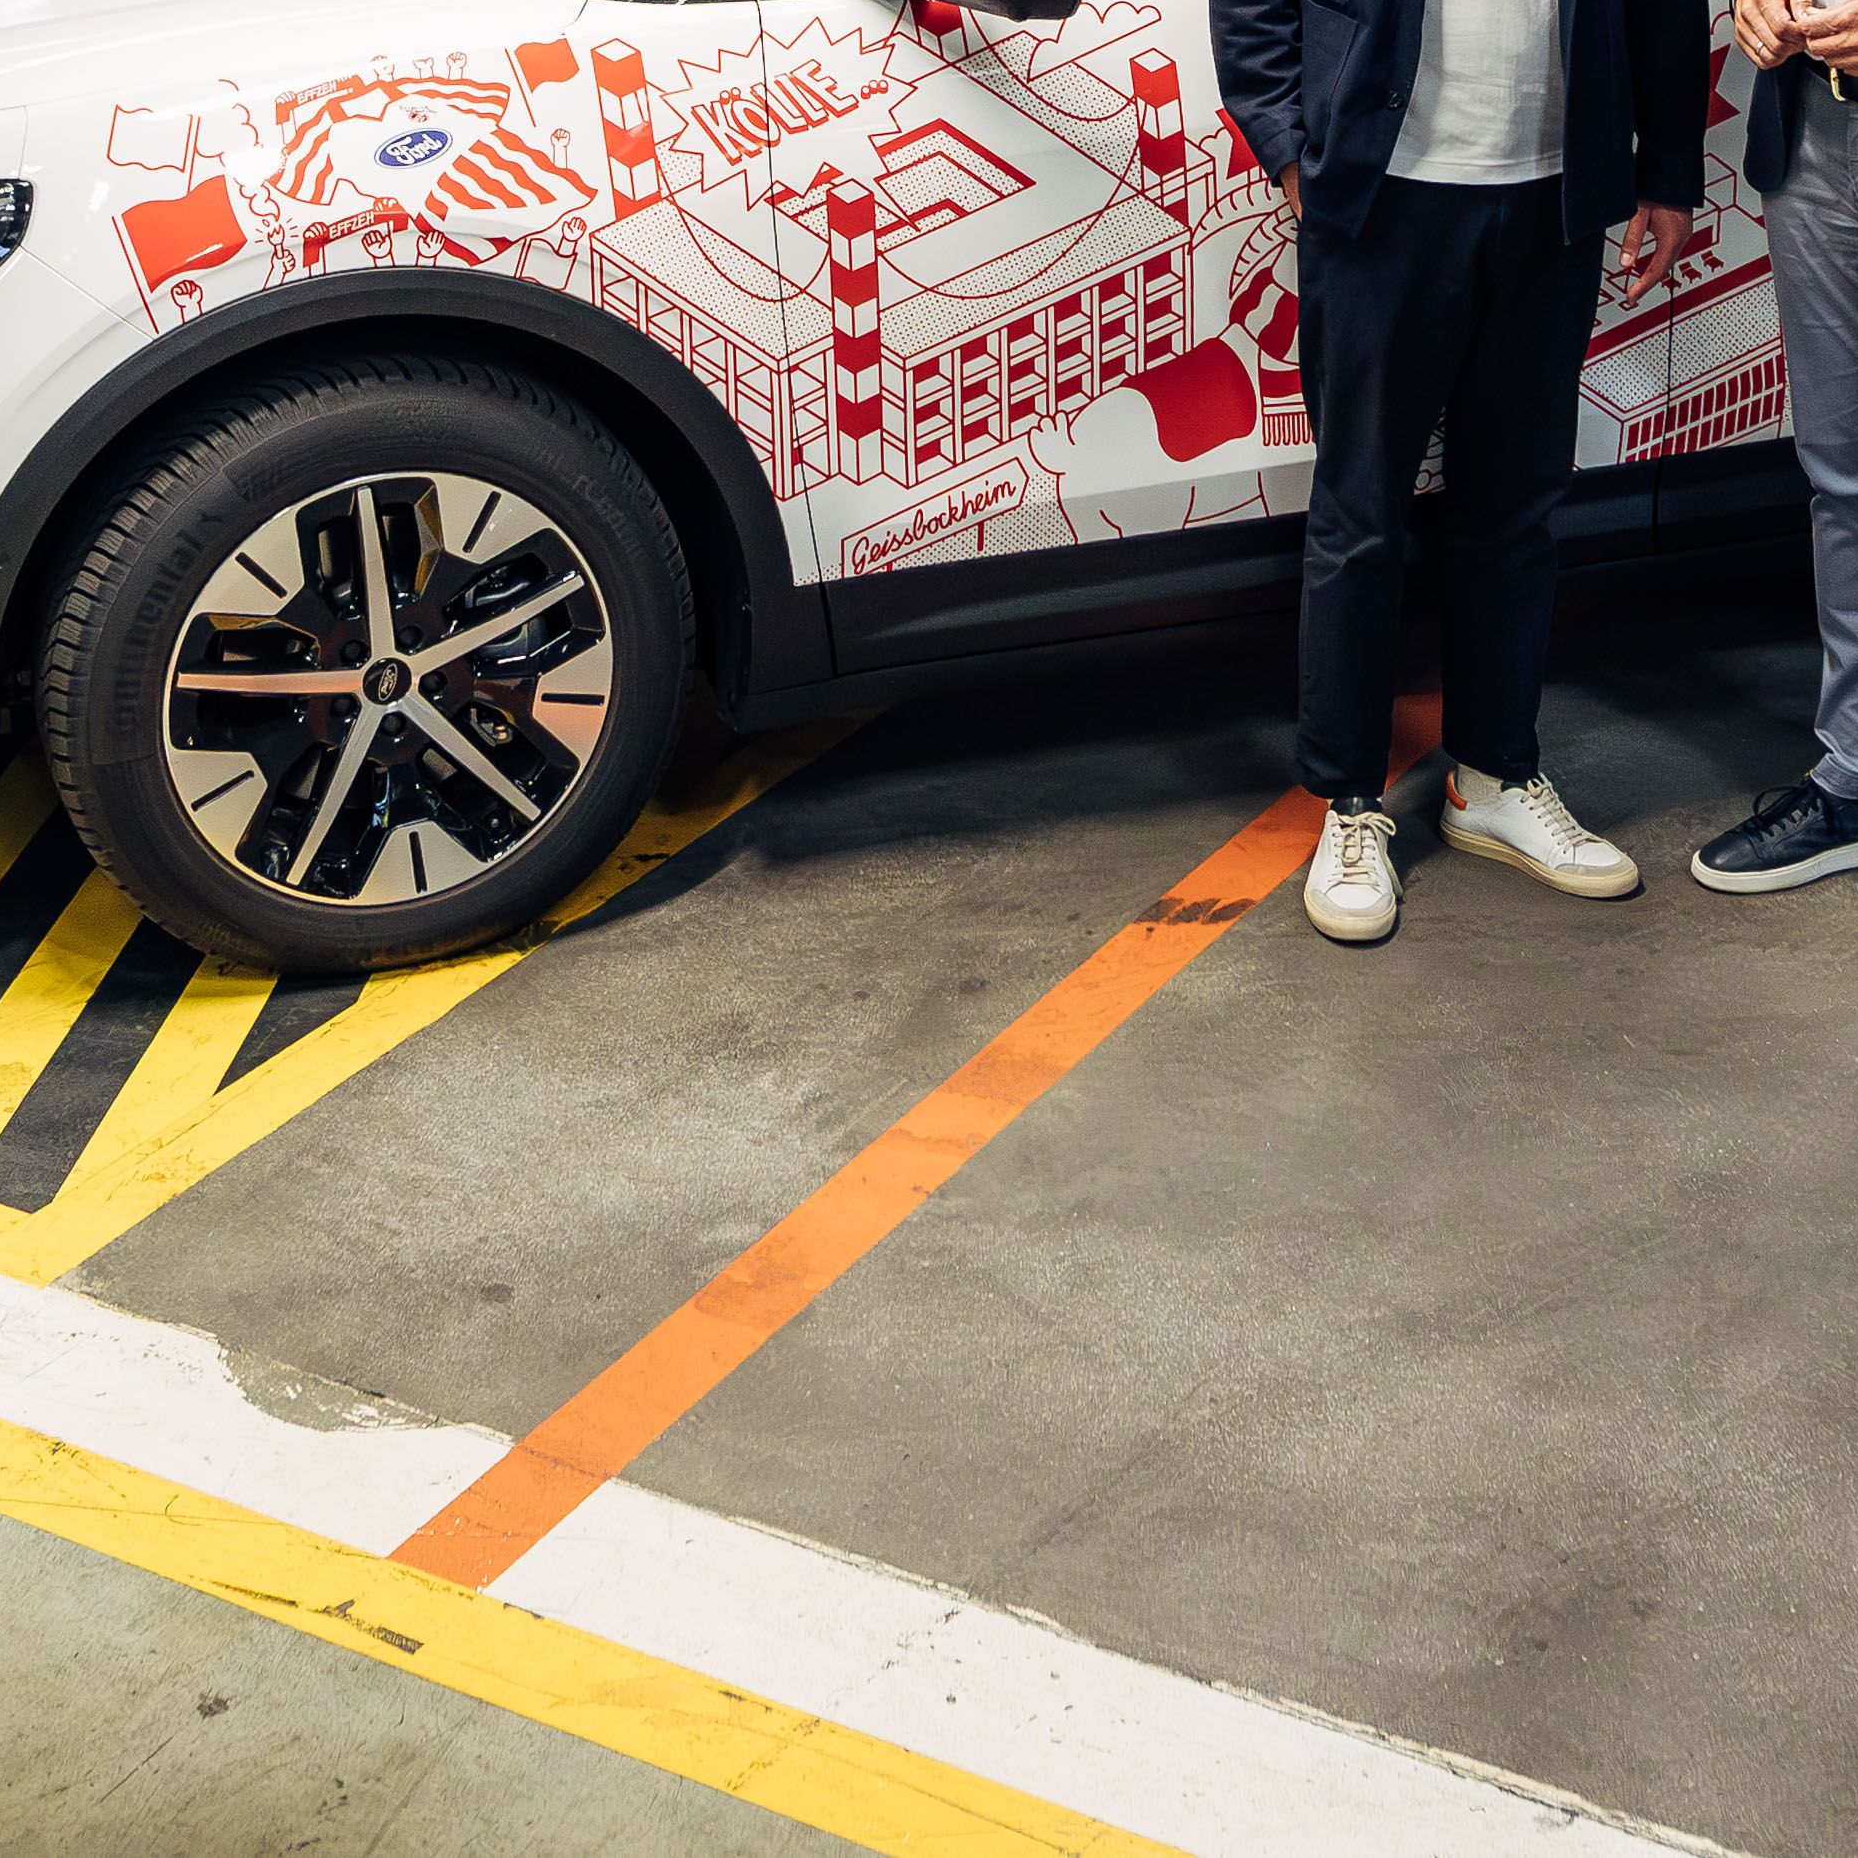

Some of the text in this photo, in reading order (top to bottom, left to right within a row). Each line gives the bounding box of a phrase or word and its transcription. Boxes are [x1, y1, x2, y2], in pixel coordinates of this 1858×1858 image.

[297, 79, 337, 104] EFFZEH
[385, 133, 444, 165] Ford
[328, 210, 375, 239] EFFZEH
[851, 477, 1017, 575] Geissbockheim
